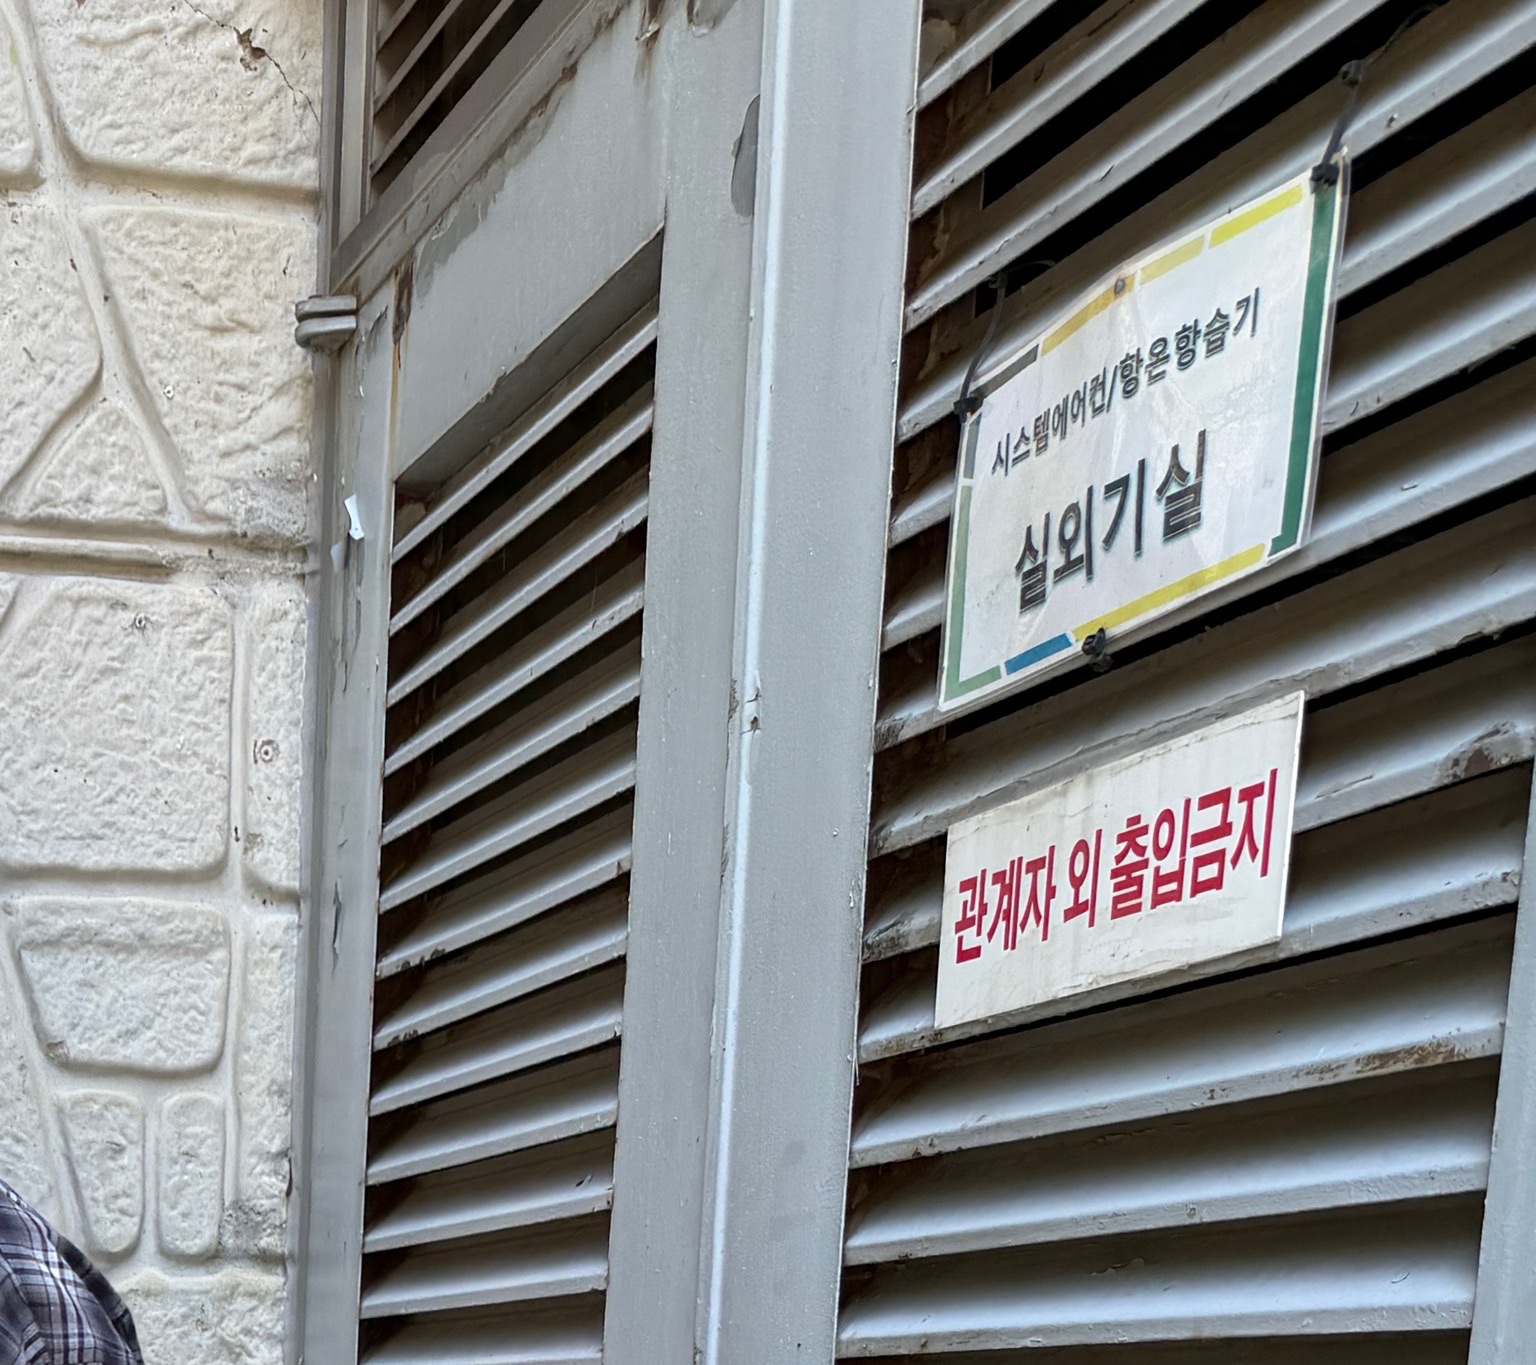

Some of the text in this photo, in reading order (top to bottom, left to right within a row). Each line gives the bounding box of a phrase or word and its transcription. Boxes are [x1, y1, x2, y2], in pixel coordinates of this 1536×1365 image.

[991, 287, 1260, 476] 시스템에어컨/항온항습기
[1015, 429, 1207, 612] 실외기실
[954, 768, 1278, 964] 관계자 외 출입금지
